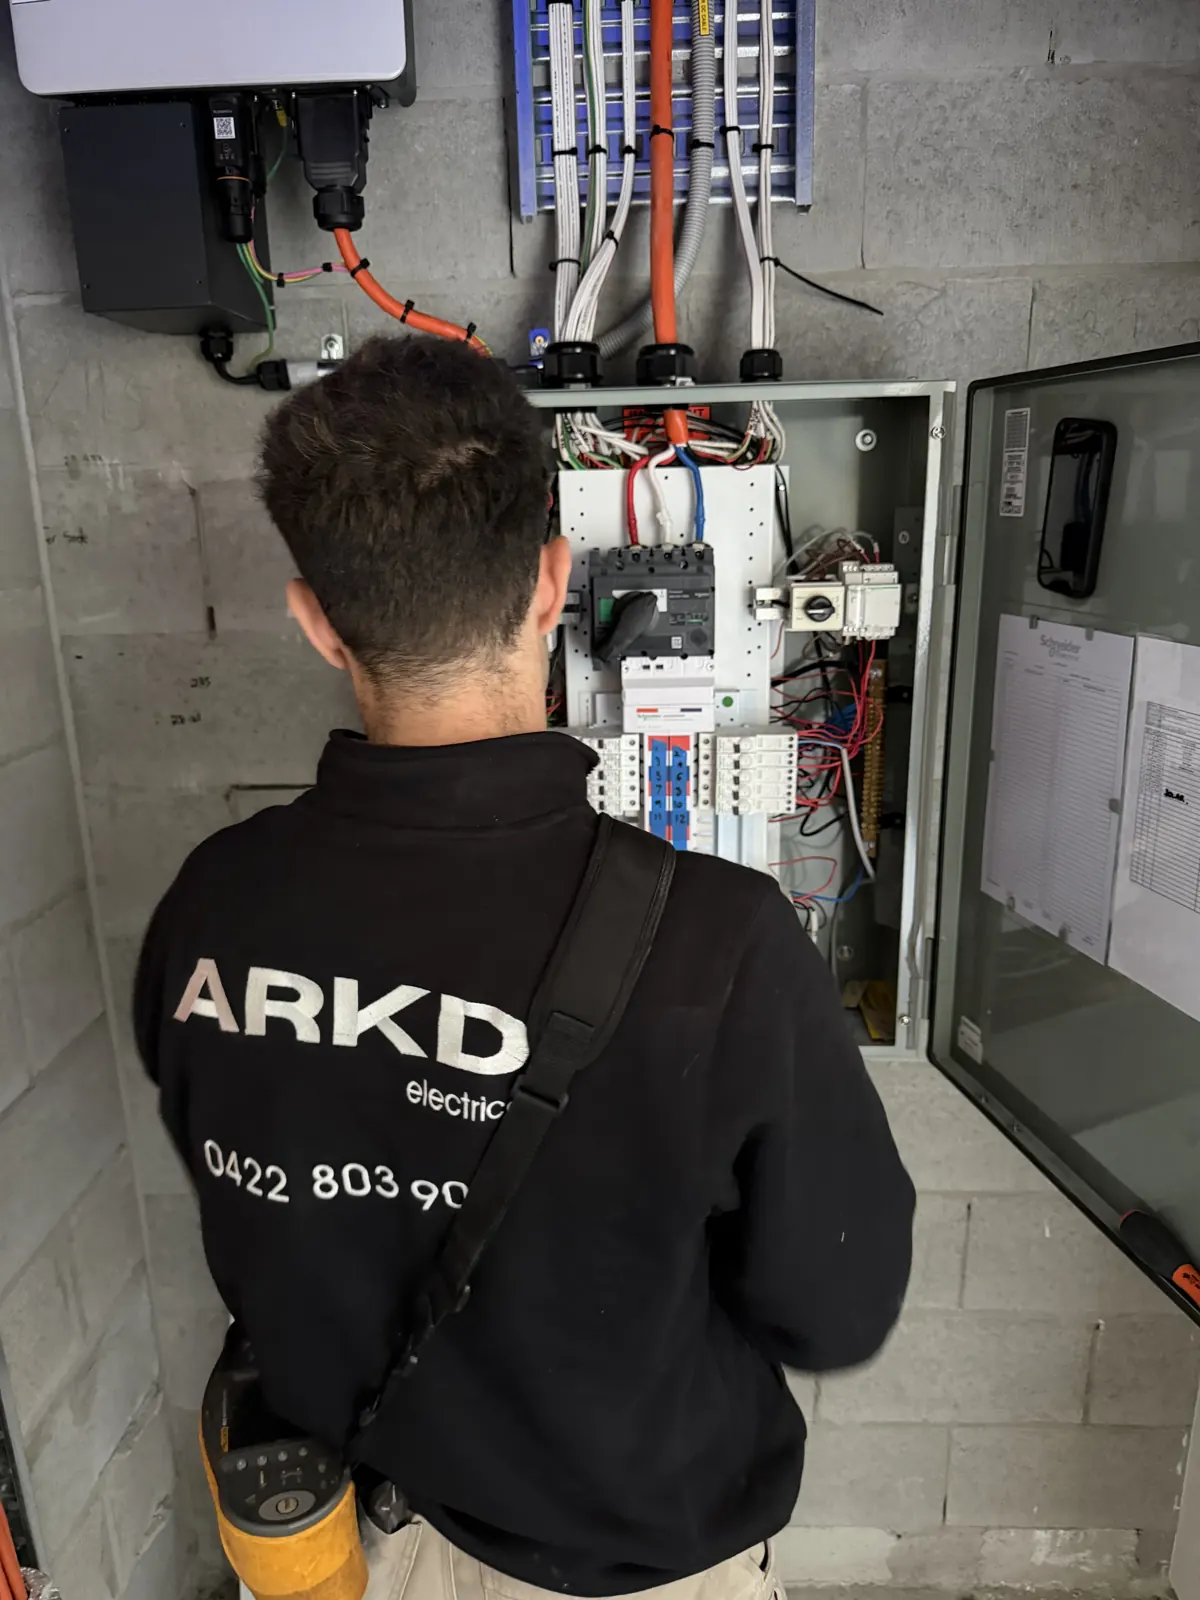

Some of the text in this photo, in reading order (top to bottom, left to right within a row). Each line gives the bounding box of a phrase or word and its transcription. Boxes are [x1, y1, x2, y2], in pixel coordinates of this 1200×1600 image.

[675, 814, 686, 824] 12
[173, 958, 530, 1075] ARKD
[406, 1079, 512, 1122] electric
[204, 1139, 289, 1203] 0422
[312, 1163, 399, 1199] 803
